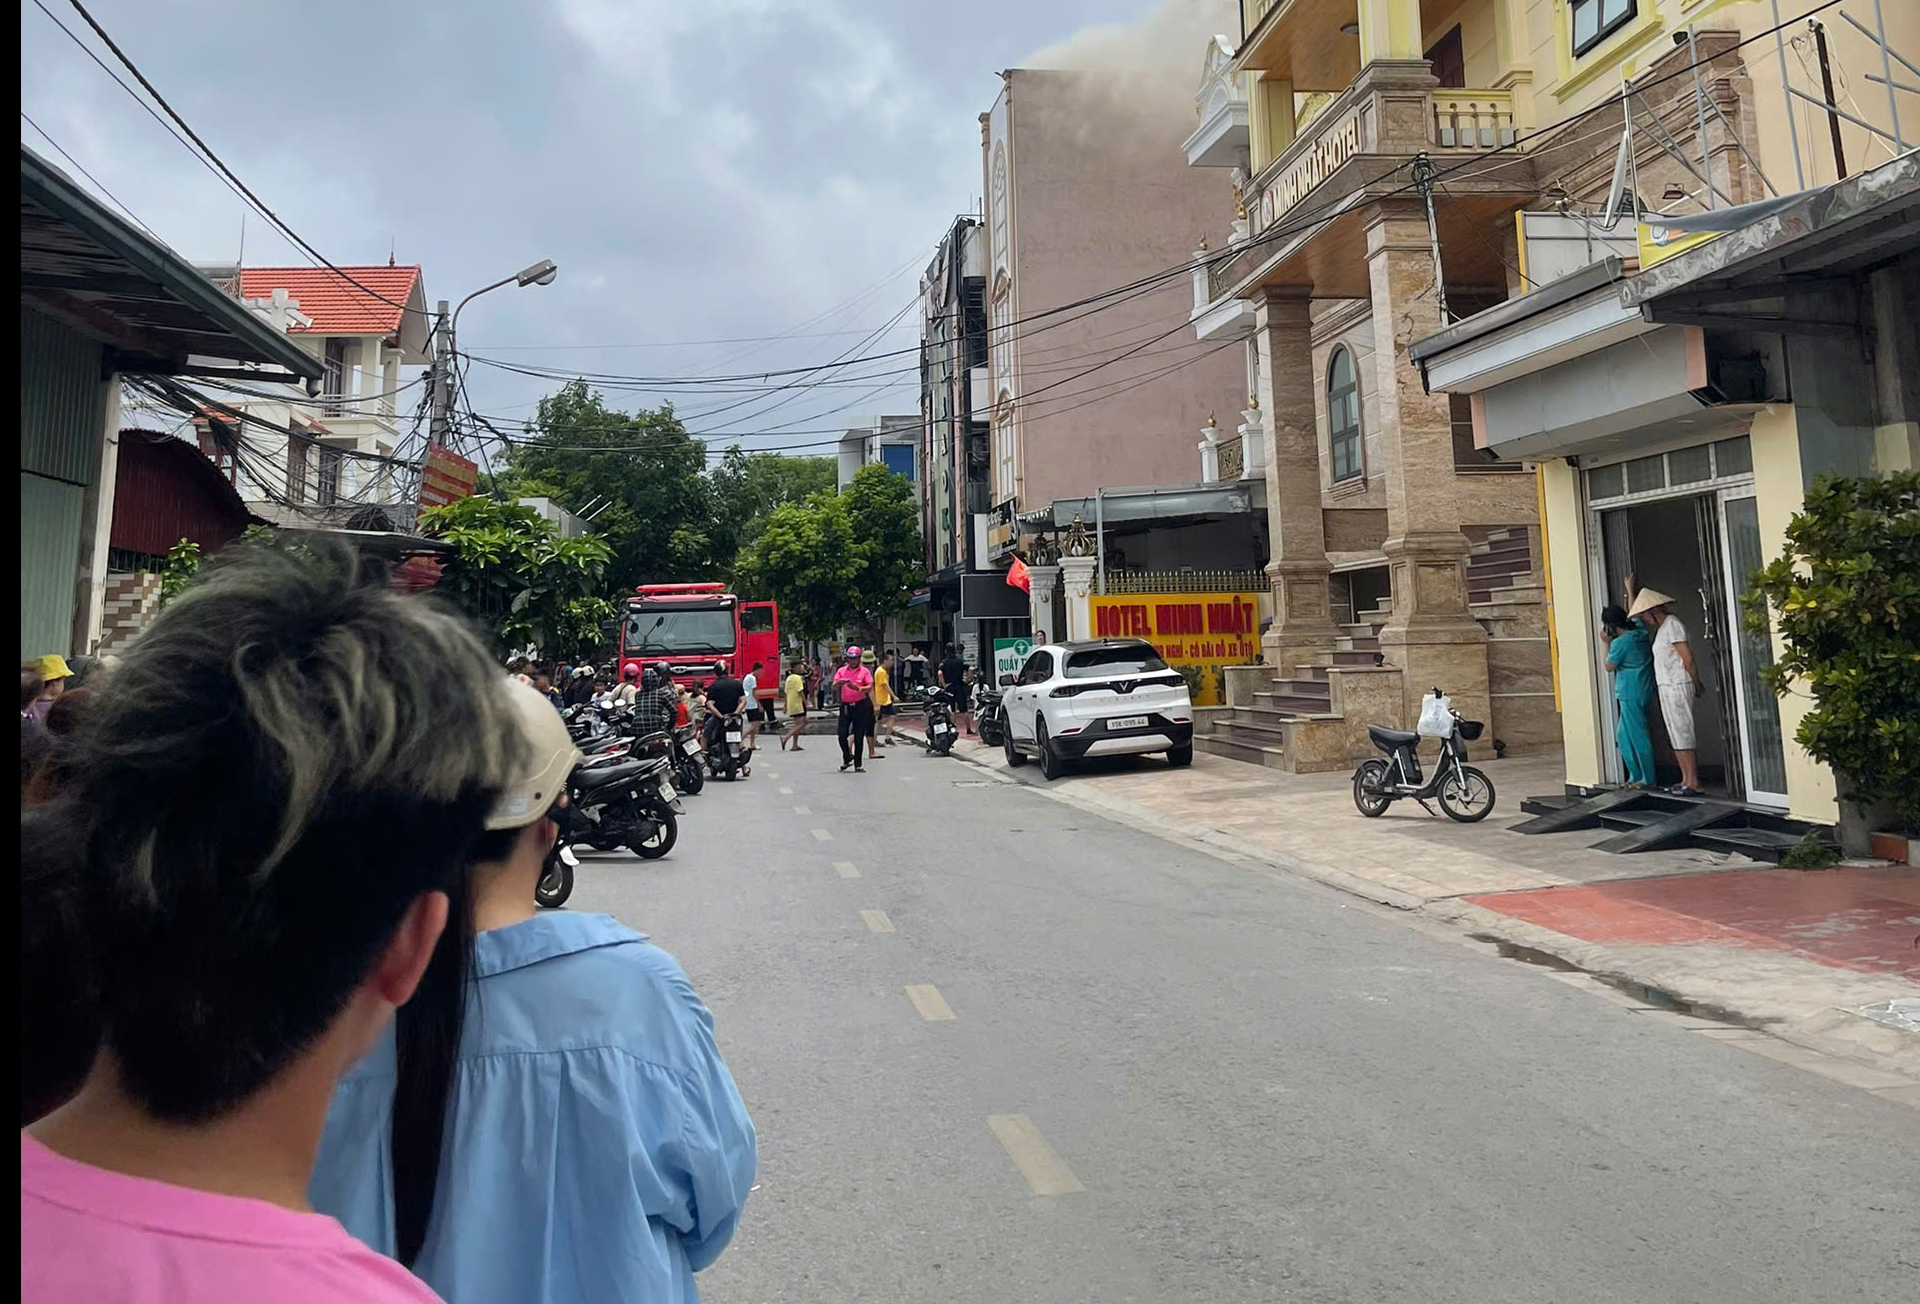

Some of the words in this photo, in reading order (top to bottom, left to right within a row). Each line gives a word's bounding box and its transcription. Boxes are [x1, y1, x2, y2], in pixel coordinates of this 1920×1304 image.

[1273, 170, 1298, 220] MINH
[1323, 117, 1359, 177] HOTEL
[1096, 605, 1152, 636] HOTEL
[1155, 603, 1204, 635] MINH
[1207, 595, 1254, 641] NHẬT
[1228, 643, 1238, 657] XE
